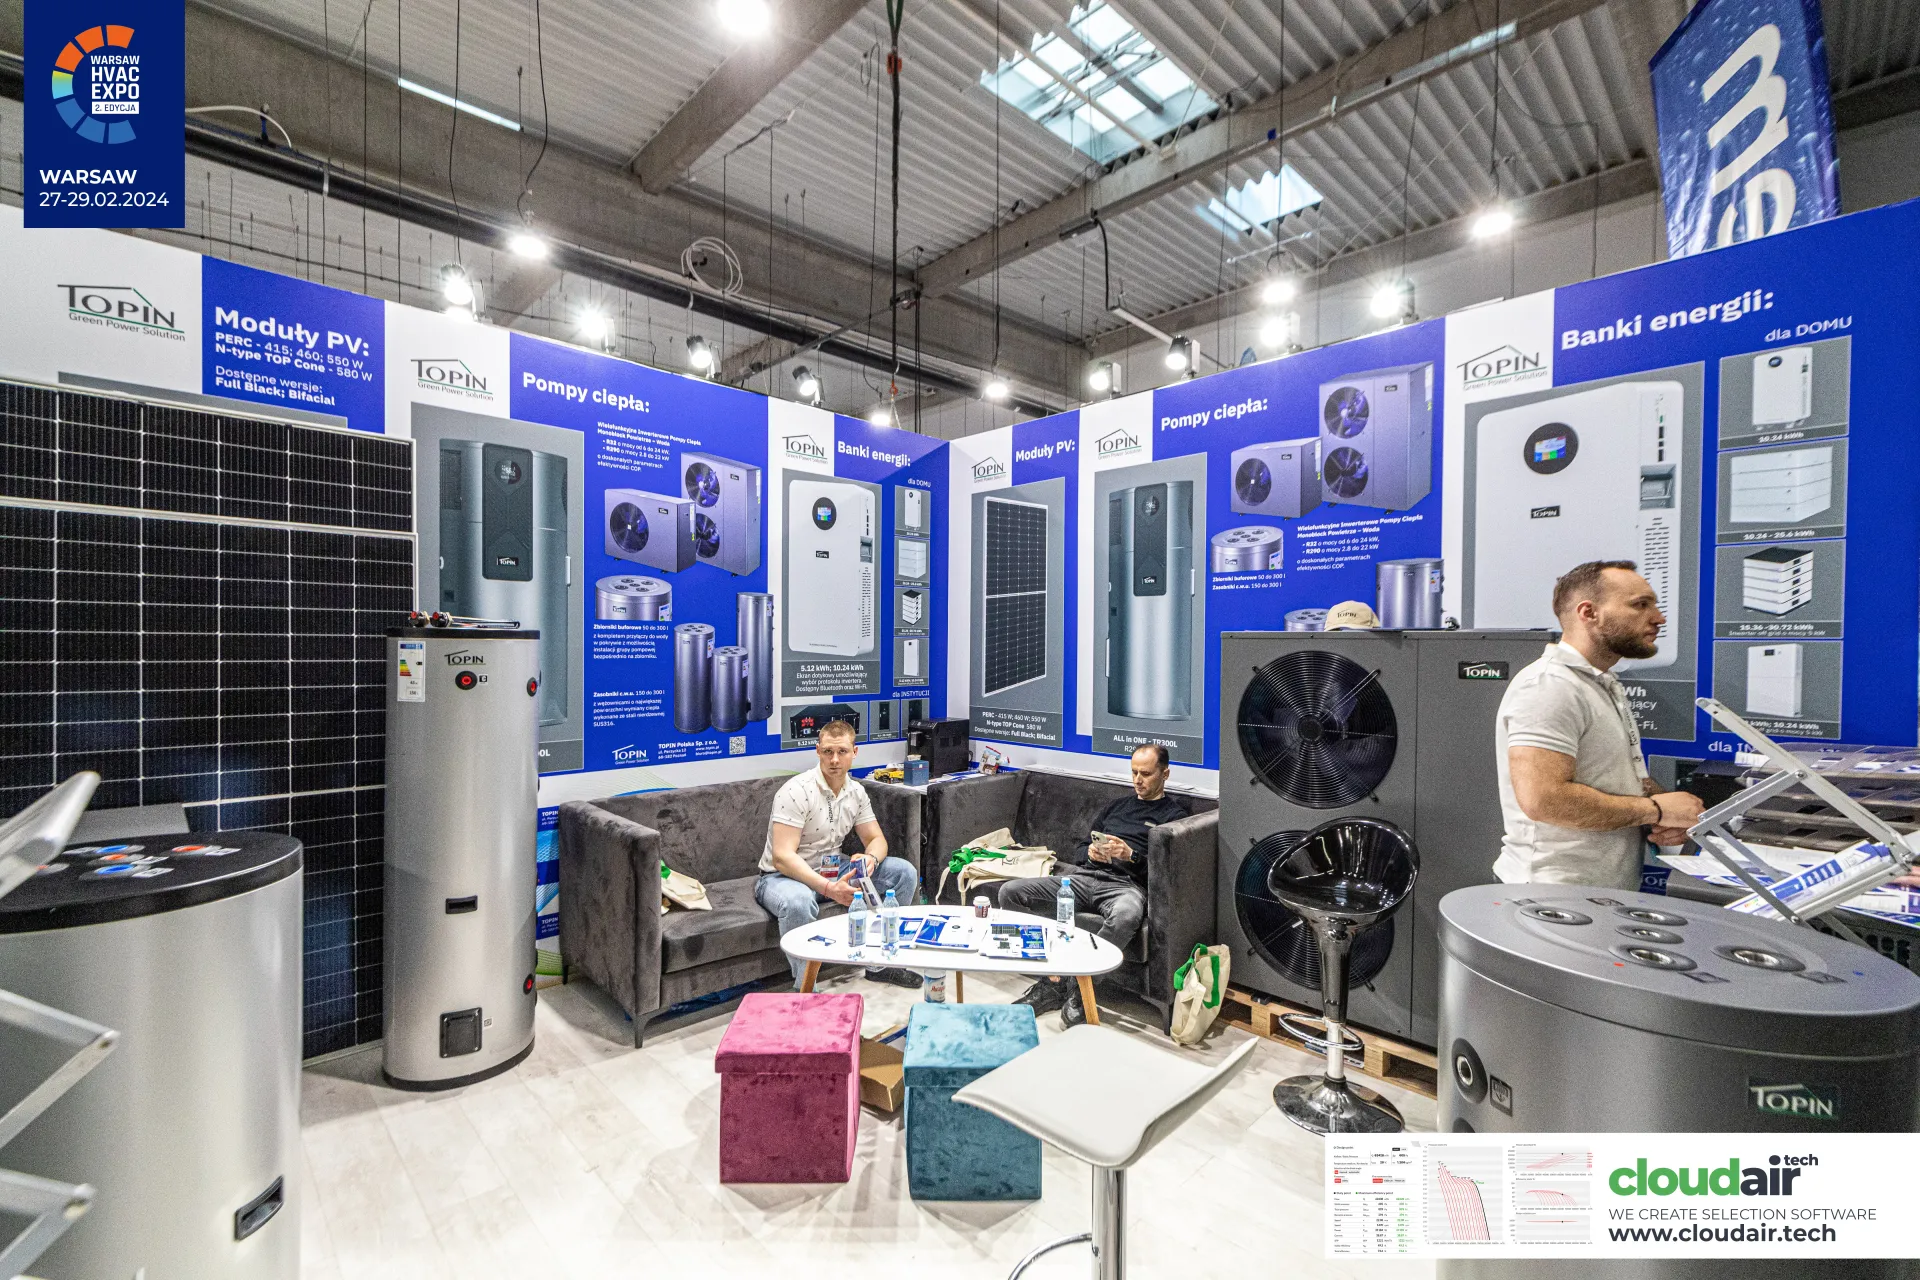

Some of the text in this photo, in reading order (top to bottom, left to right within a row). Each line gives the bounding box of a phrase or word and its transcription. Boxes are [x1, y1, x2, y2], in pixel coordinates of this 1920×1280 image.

[57, 284, 175, 328] TOPIN
[1561, 289, 1774, 350] Banki energii:
[69, 312, 186, 342] Green Power Solution
[215, 306, 370, 357] Moduły PV:
[1764, 316, 1852, 343] dla DOMU
[215, 331, 364, 370] PERC 415; 460; 550 W
[215, 343, 373, 382] N-type TOP Cone 580 W
[1457, 344, 1540, 381] TOPIN
[215, 365, 323, 394] Dostępne wersje:
[410, 359, 487, 390] TOPIN
[1462, 368, 1548, 392] Green Power Solution
[215, 376, 336, 407] Full Black; Bifacial
[417, 381, 494, 402] Green Power Solution
[523, 371, 650, 414] Pompy ciepła:
[1161, 398, 1268, 431] Pompy ciepła:
[782, 435, 824, 456] TOPIN
[838, 440, 910, 467] Banki energii:
[1016, 439, 1076, 462] Moduły PV:
[1094, 429, 1138, 452] TOPIN
[972, 456, 1004, 477] TOPIN
[916, 479, 931, 488] DOMU
[1380, 516, 1401, 524] Pompy
[1532, 506, 1558, 518] TOPIN
[444, 650, 484, 665] TOPIN
[1464, 664, 1500, 677] TOPIN
[1622, 686, 1646, 697] Wh
[612, 744, 646, 760] TOPIN
[1708, 741, 1732, 752] dla
[1750, 1083, 1833, 1117] TOPIN
